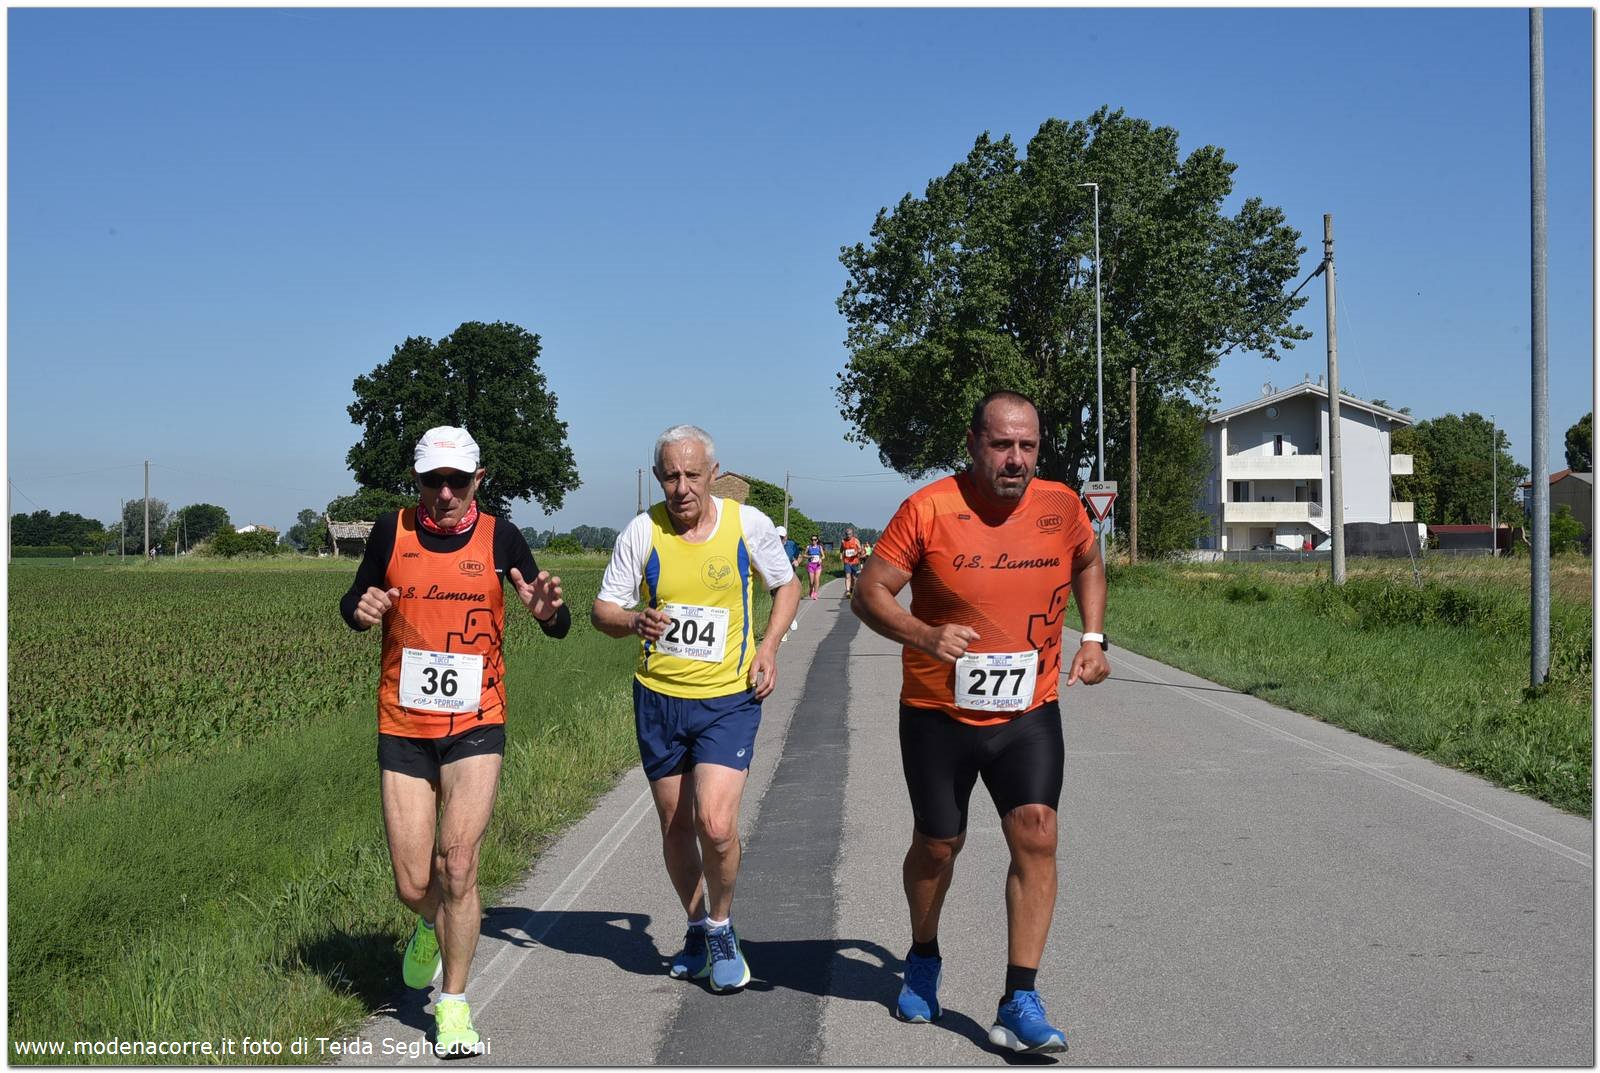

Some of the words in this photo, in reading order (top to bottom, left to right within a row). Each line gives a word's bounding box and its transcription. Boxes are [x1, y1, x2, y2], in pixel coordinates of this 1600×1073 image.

[952, 553, 985, 571] G.S.
[989, 552, 1061, 570] Lamone
[423, 584, 486, 602] Lamone
[665, 618, 715, 646] 204
[421, 668, 459, 697] 36
[968, 668, 1026, 696] 277
